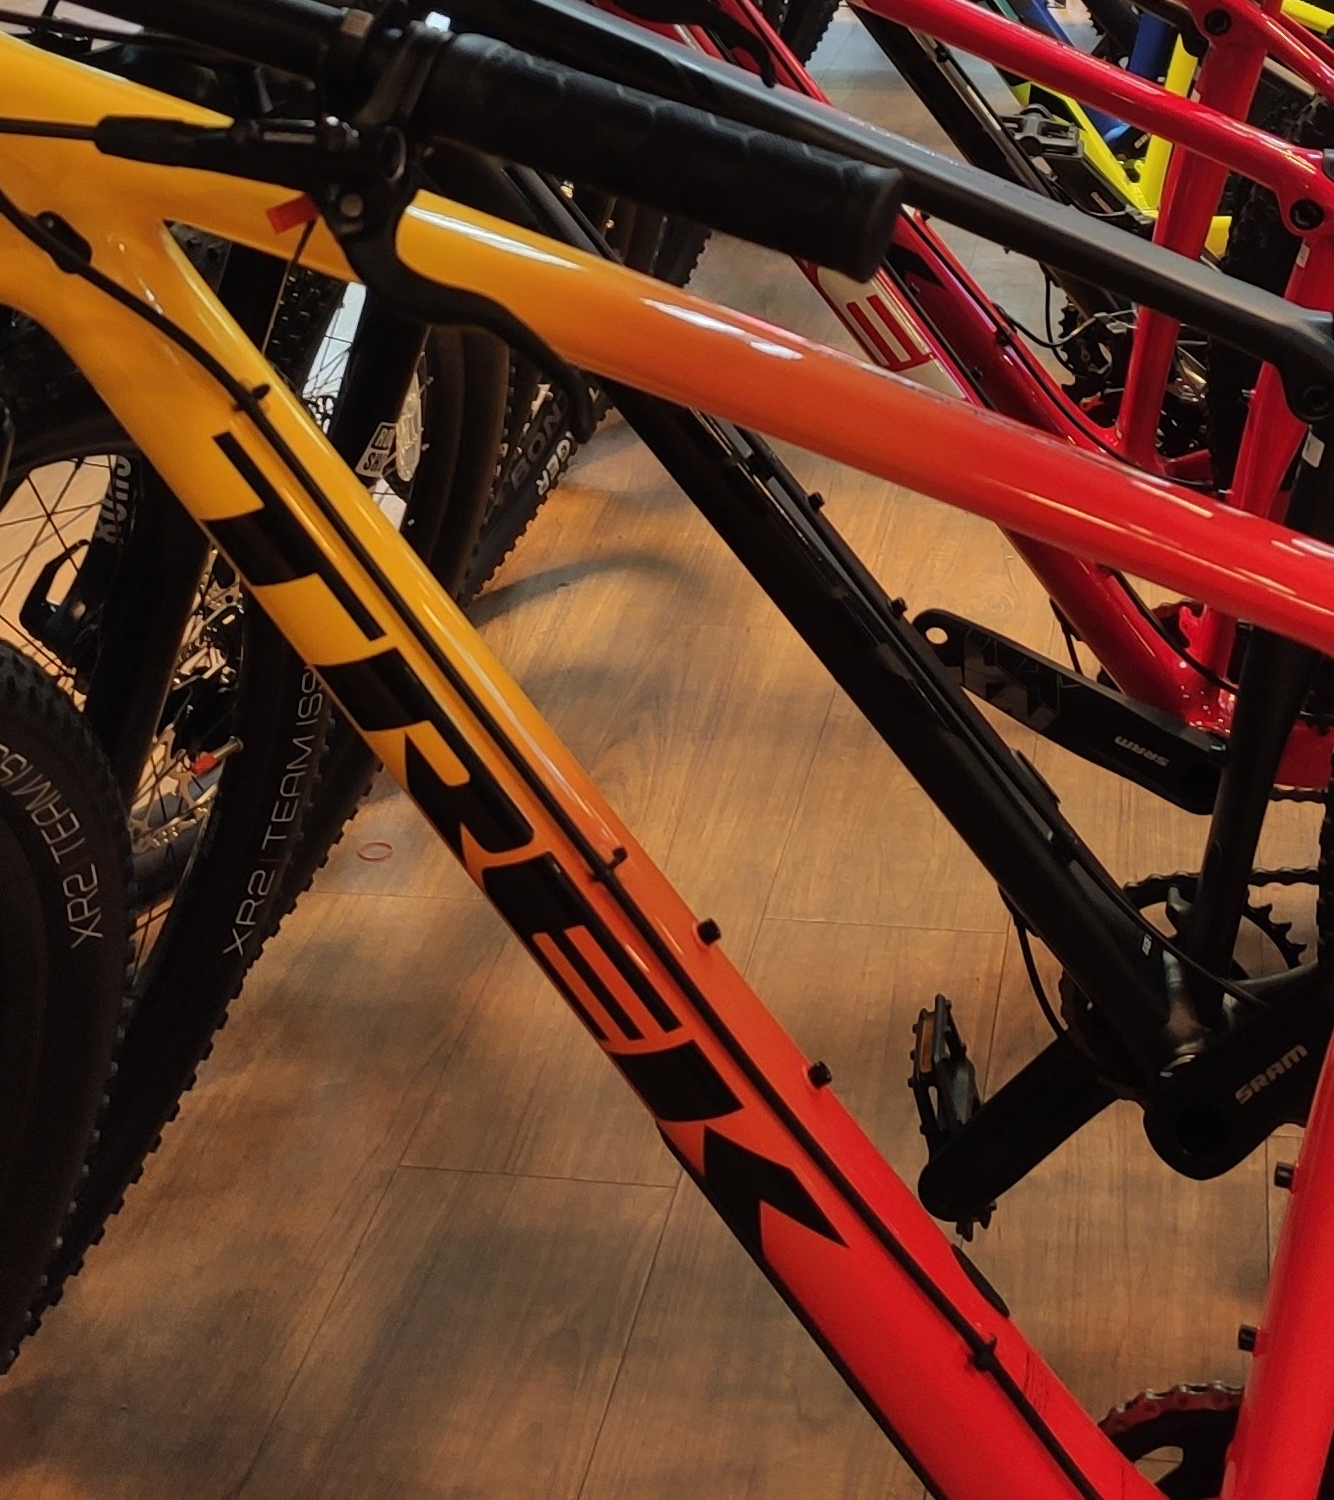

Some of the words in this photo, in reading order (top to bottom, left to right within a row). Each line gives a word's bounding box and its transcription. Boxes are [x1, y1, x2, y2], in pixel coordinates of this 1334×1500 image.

[1113, 733, 1172, 769] SRAM
[11, 772, 87, 865] TEAM
[206, 430, 848, 1258] TREK
[223, 867, 276, 956] XR2
[262, 732, 316, 851] TEAM
[61, 861, 104, 949] XR2
[1234, 1043, 1309, 1107] SRAM
